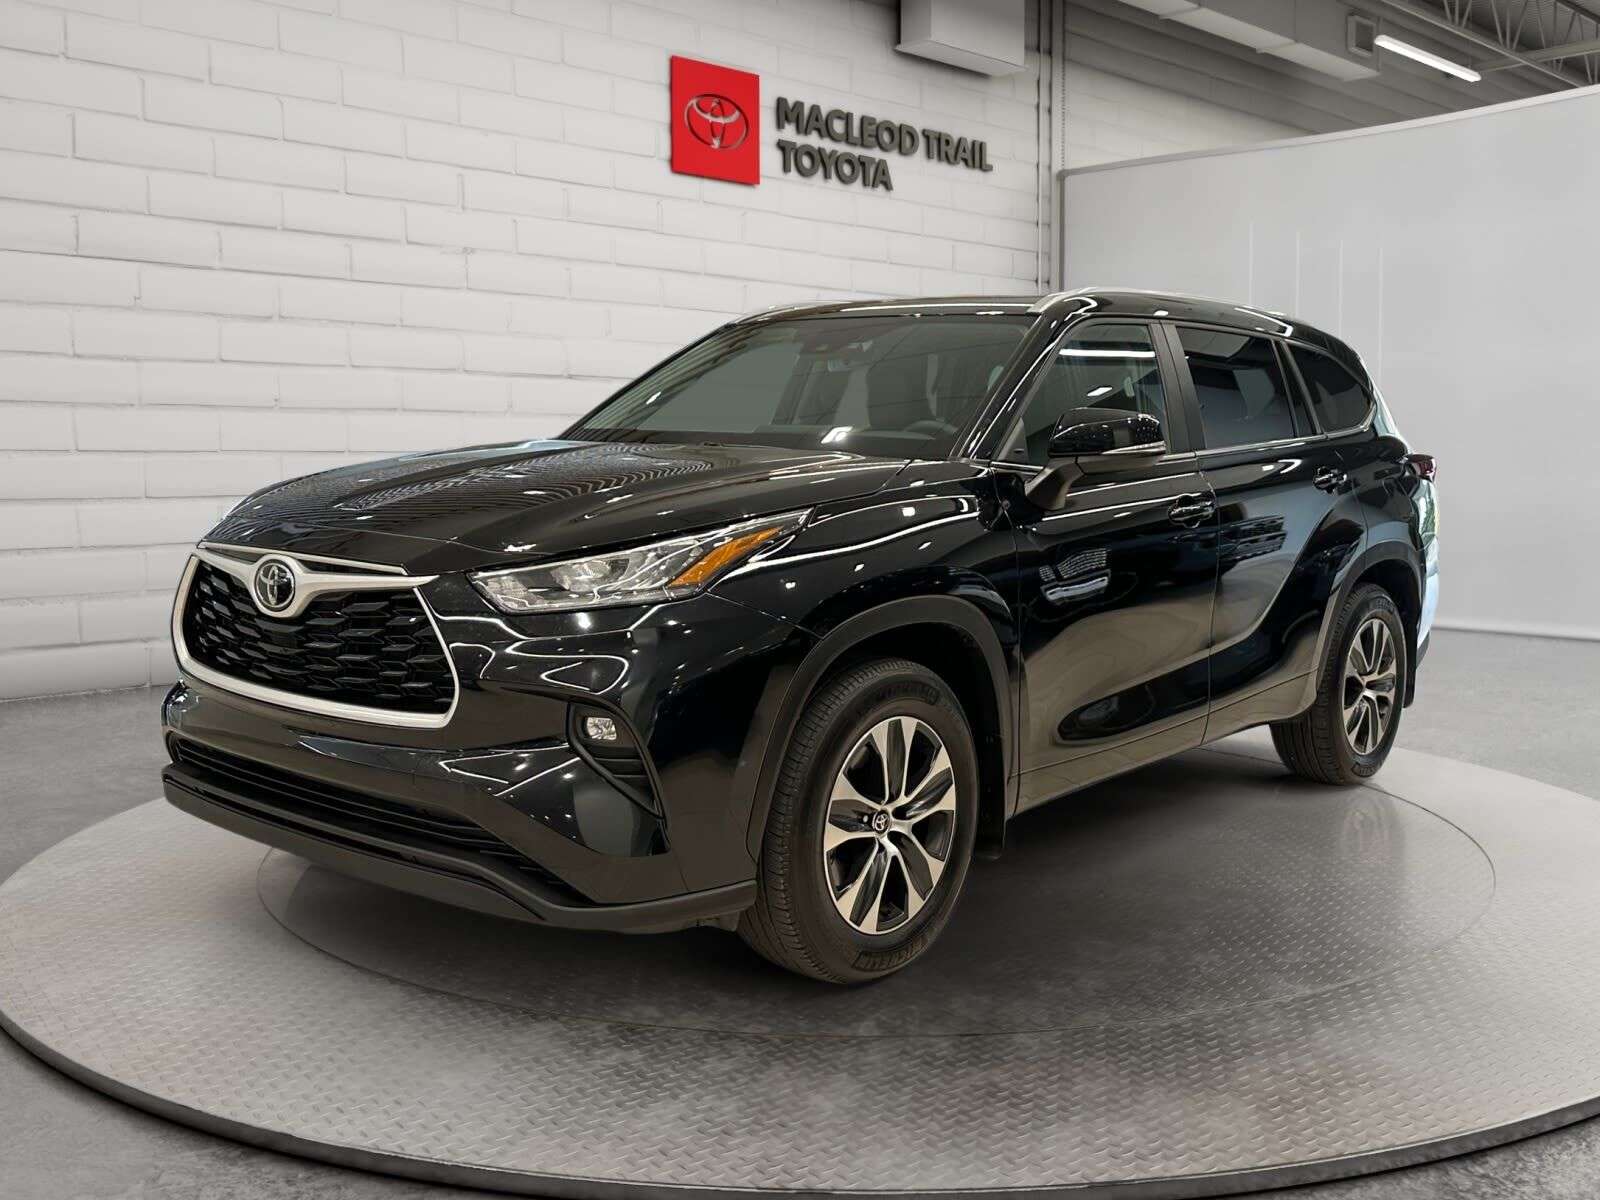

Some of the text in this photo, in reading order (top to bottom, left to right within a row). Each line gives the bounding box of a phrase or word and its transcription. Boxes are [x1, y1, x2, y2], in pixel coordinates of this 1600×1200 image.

[776, 97, 993, 172] MACLEOD TRAIL
[776, 139, 894, 191] TOYOTA
